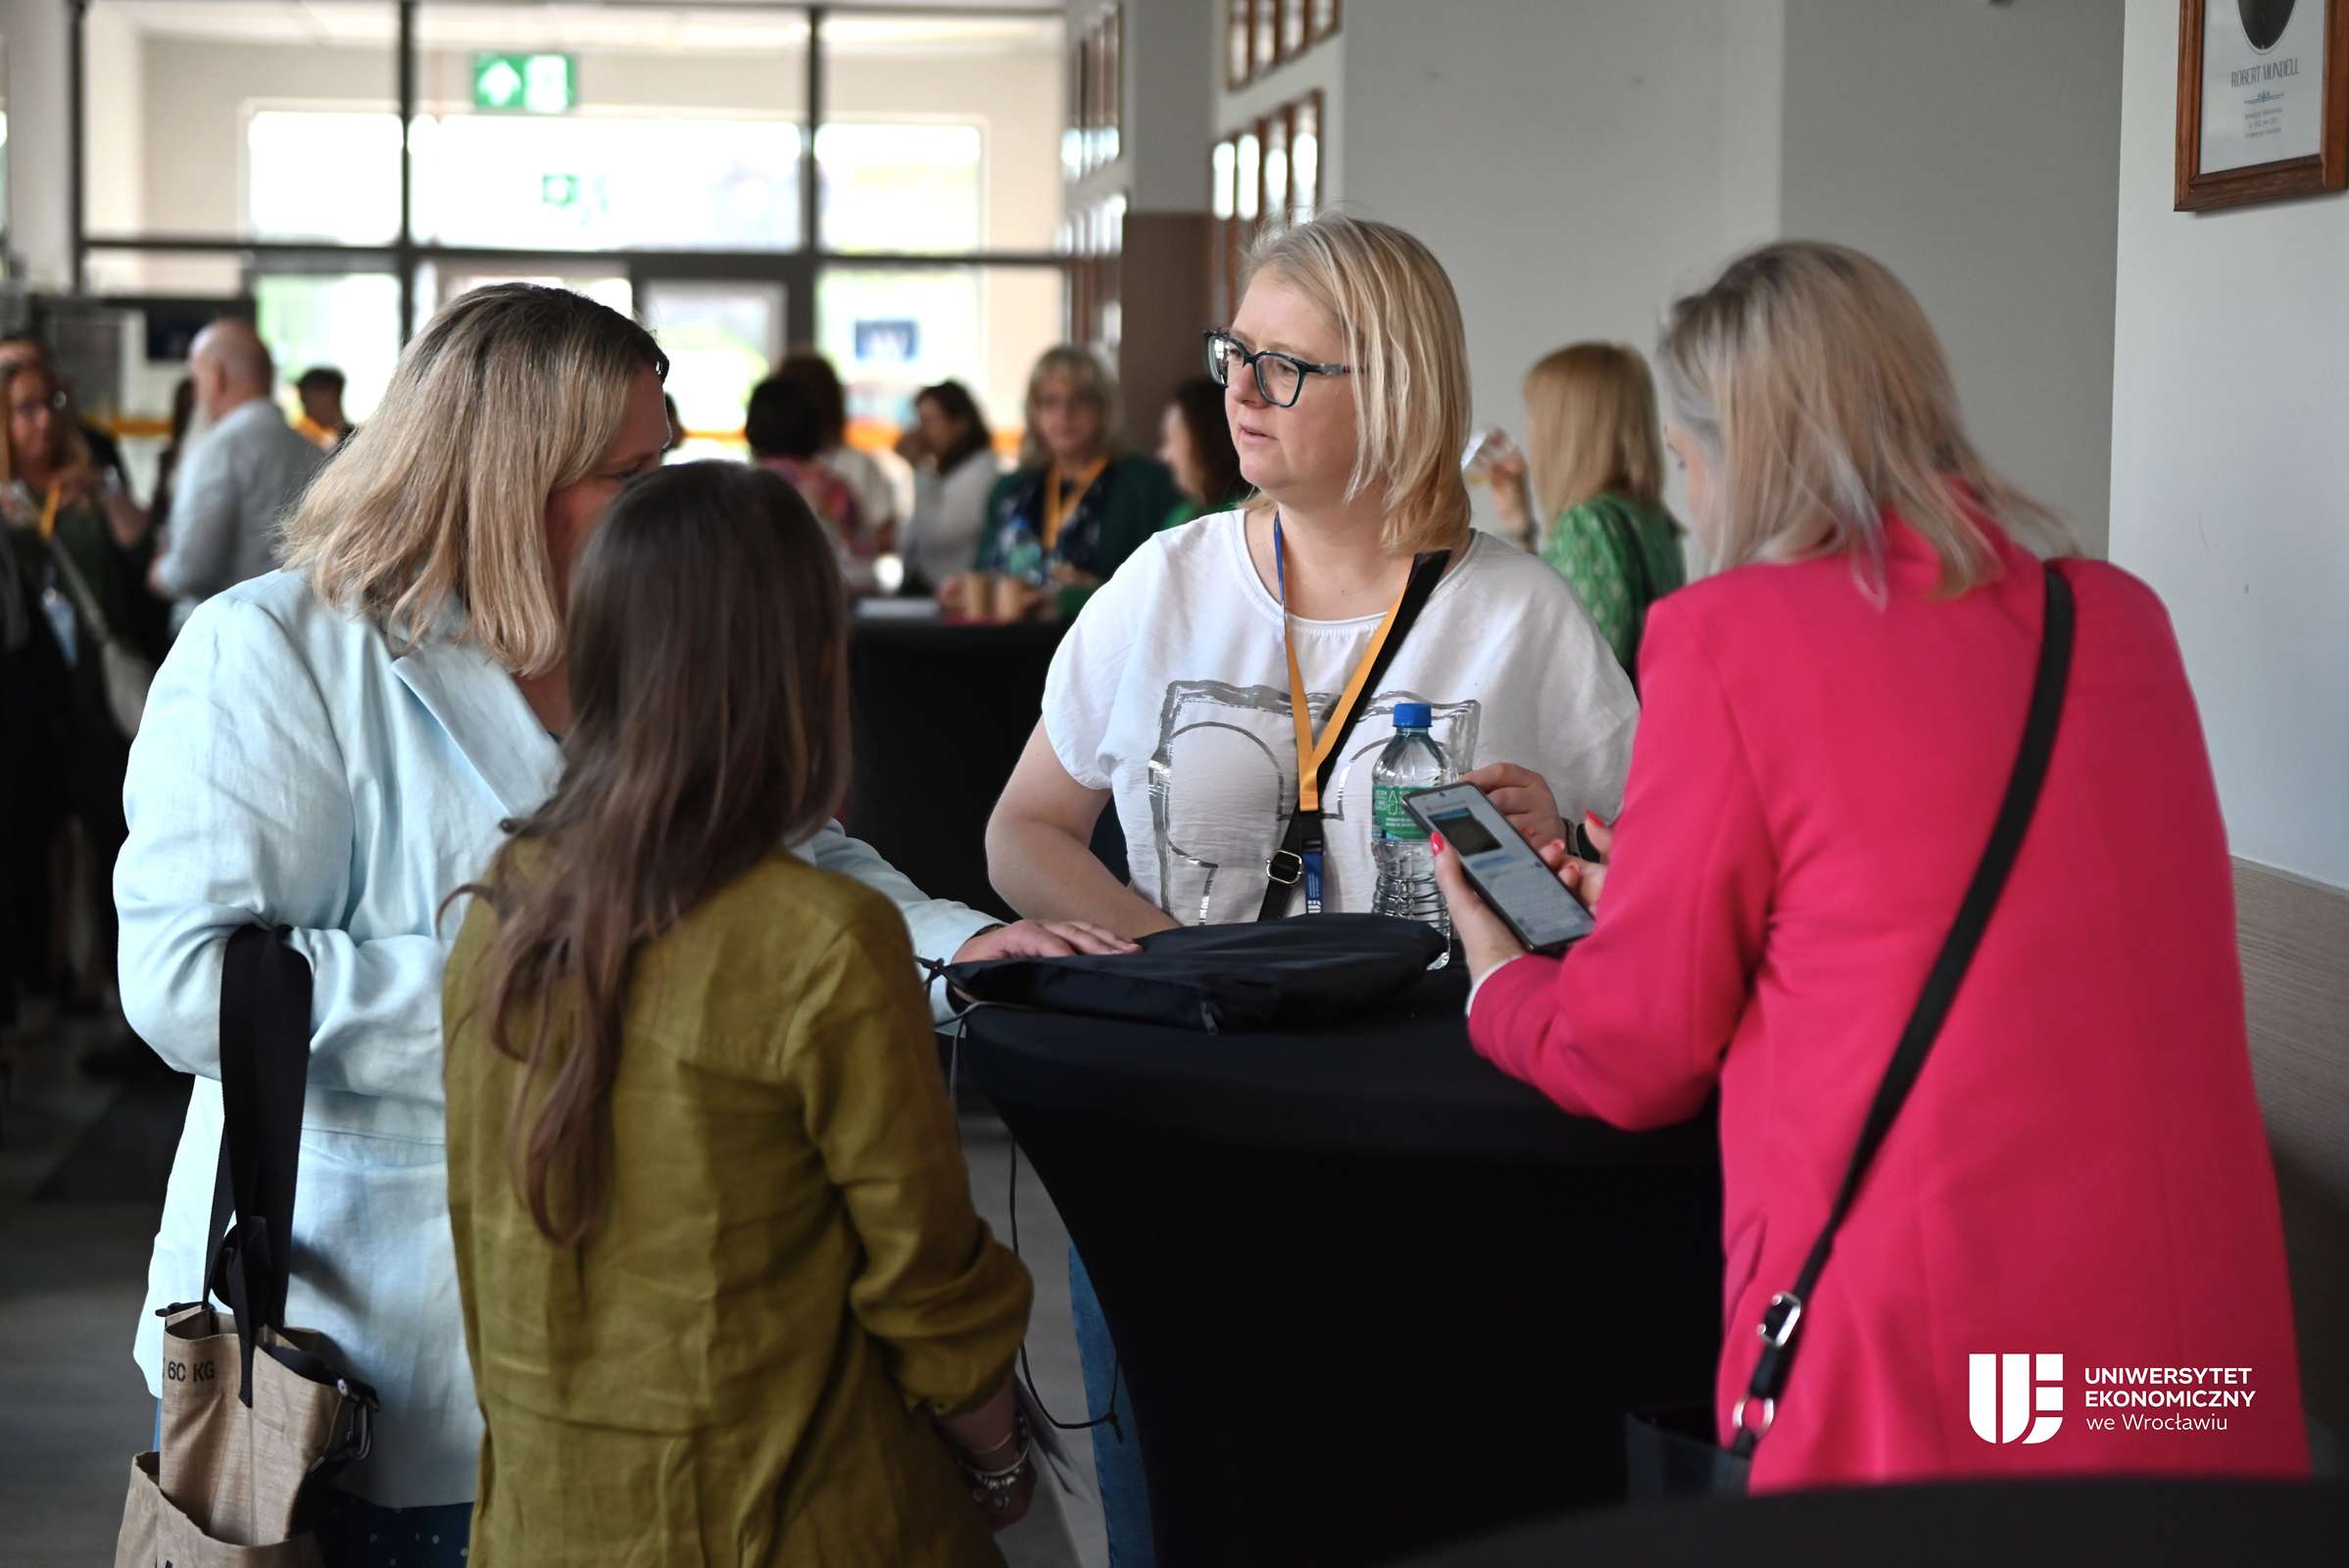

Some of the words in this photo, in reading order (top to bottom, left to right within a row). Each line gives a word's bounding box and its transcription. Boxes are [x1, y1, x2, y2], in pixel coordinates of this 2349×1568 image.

[2230, 65, 2262, 88] ROBERT
[2263, 58, 2301, 80] MUNDELL
[193, 1360, 216, 1383] KG
